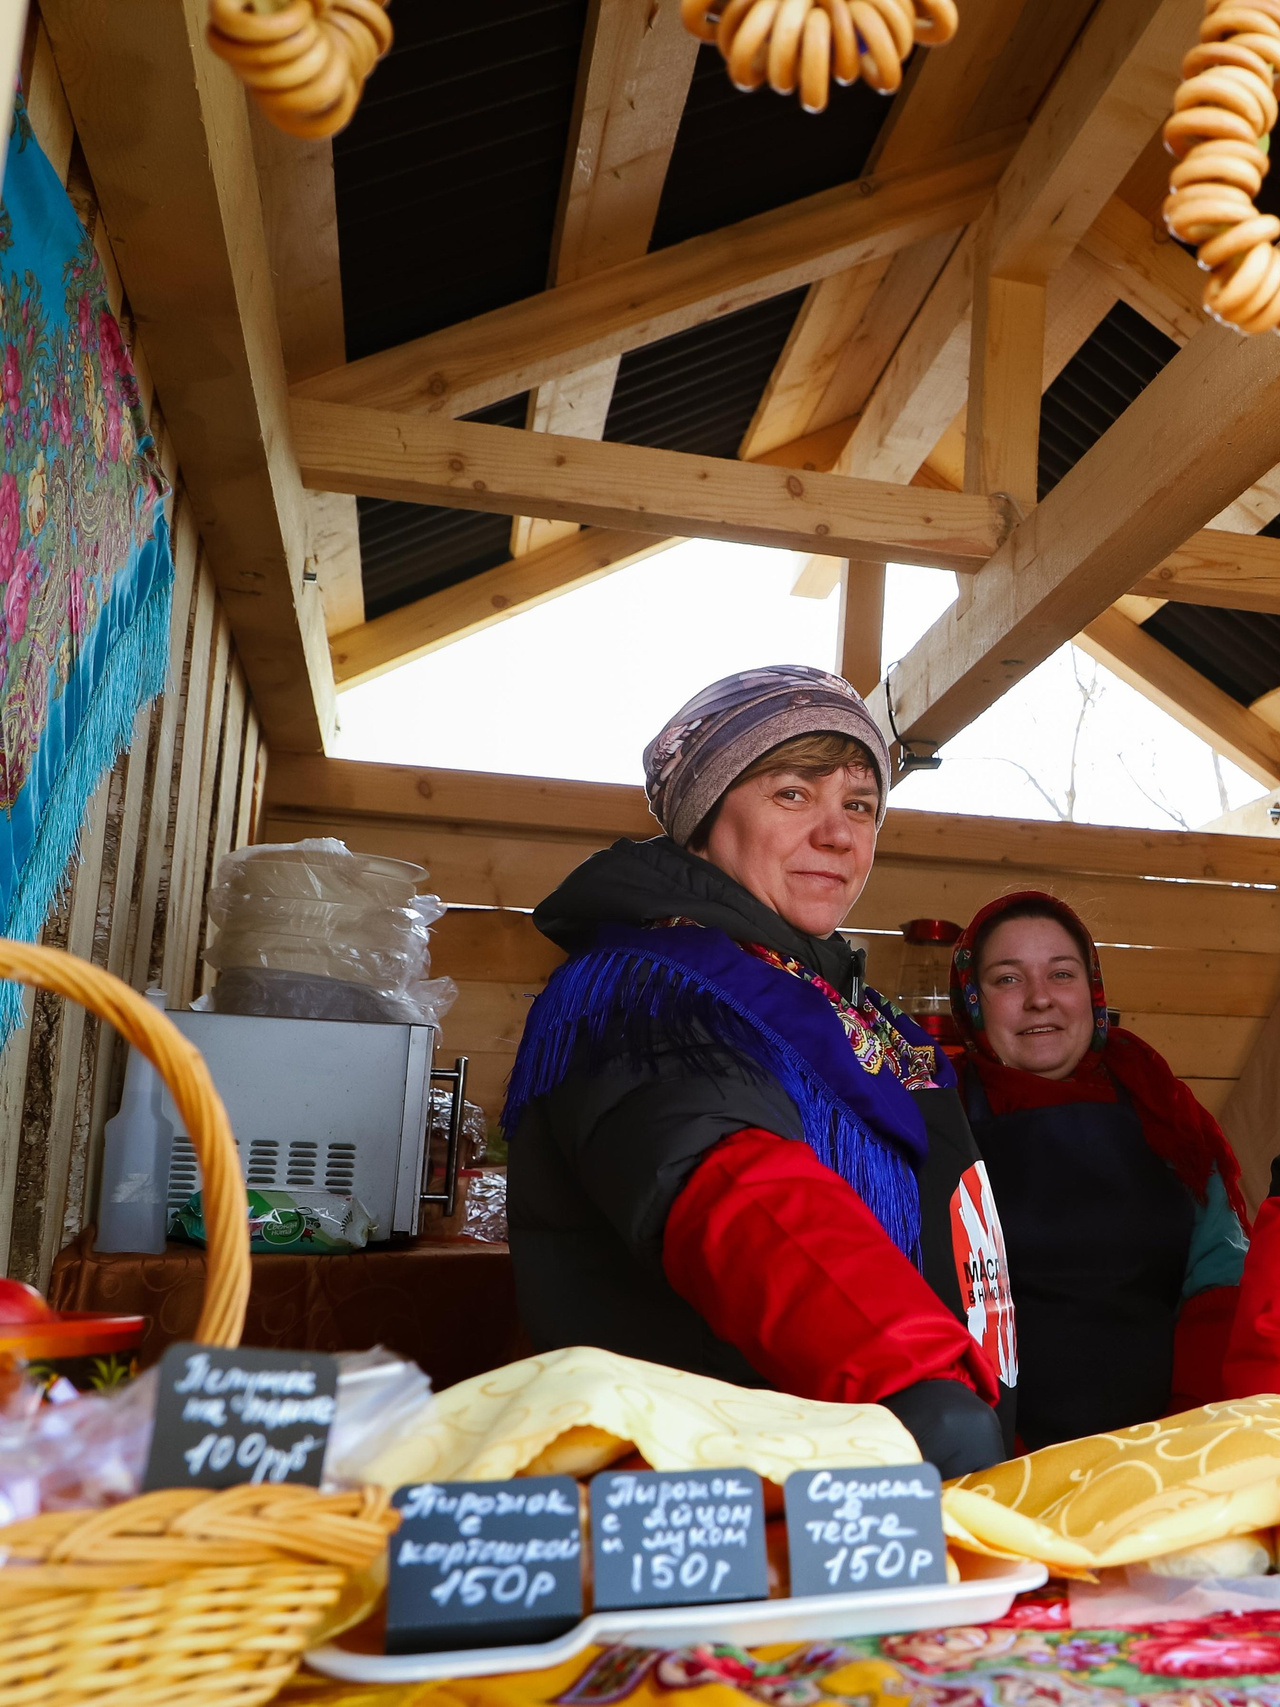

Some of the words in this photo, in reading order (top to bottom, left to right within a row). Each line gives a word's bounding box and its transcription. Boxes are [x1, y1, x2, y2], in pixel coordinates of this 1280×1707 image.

[403, 1484, 575, 1521] Пирожок
[605, 1476, 753, 1509] Пирожок
[807, 1471, 934, 1503] Сосиска
[398, 1530, 580, 1571] картошкой
